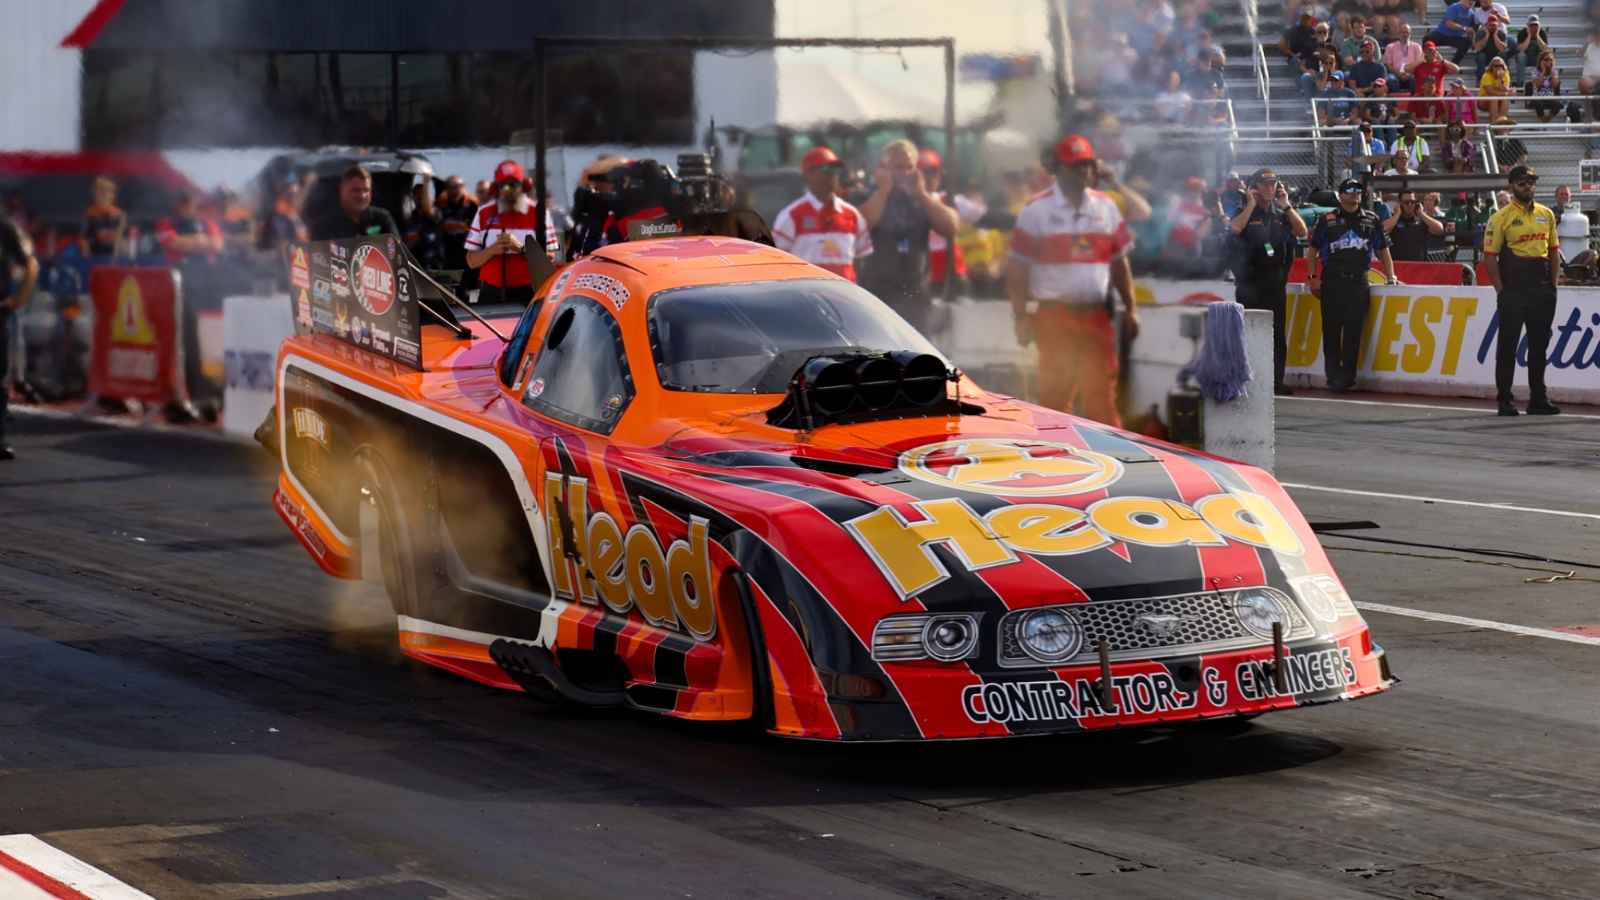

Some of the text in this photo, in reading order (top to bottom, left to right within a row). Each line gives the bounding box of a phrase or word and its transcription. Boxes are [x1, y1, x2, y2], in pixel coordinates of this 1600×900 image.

[1330, 238, 1371, 254] PEAK
[1518, 232, 1549, 243] DHL
[363, 266, 377, 290] RED
[377, 270, 392, 295] LINE
[572, 273, 615, 296] SPENCER
[297, 411, 327, 444] HYDE
[545, 470, 718, 642] Head
[842, 487, 1307, 601] Head
[1203, 667, 1228, 707] &
